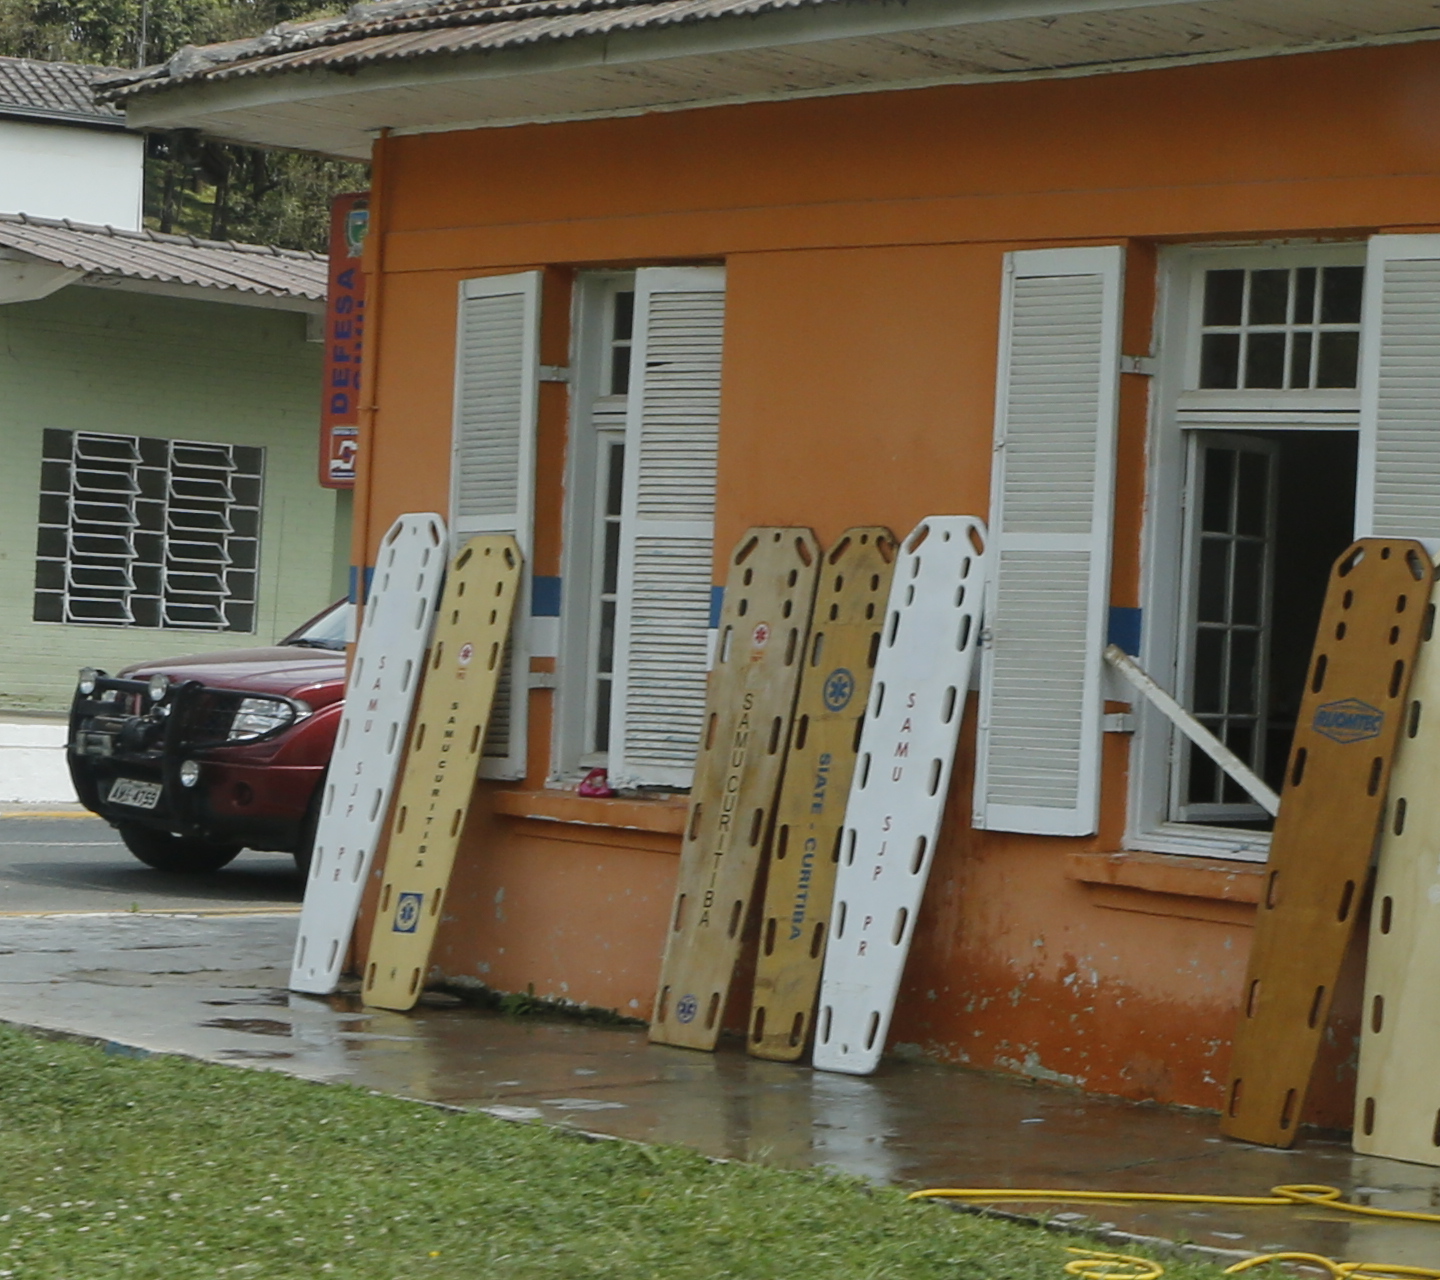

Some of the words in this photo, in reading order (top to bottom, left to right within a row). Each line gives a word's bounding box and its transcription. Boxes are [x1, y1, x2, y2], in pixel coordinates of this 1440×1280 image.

[330, 268, 356, 414] DEFESA
[364, 655, 387, 733] SAMU
[892, 693, 917, 783] SAMU
[811, 753, 832, 815] SIATE
[698, 774, 739, 928] CURITIBA
[788, 837, 817, 941] CURITIBA
[872, 816, 893, 882] SJP
[857, 915, 872, 958] PR
